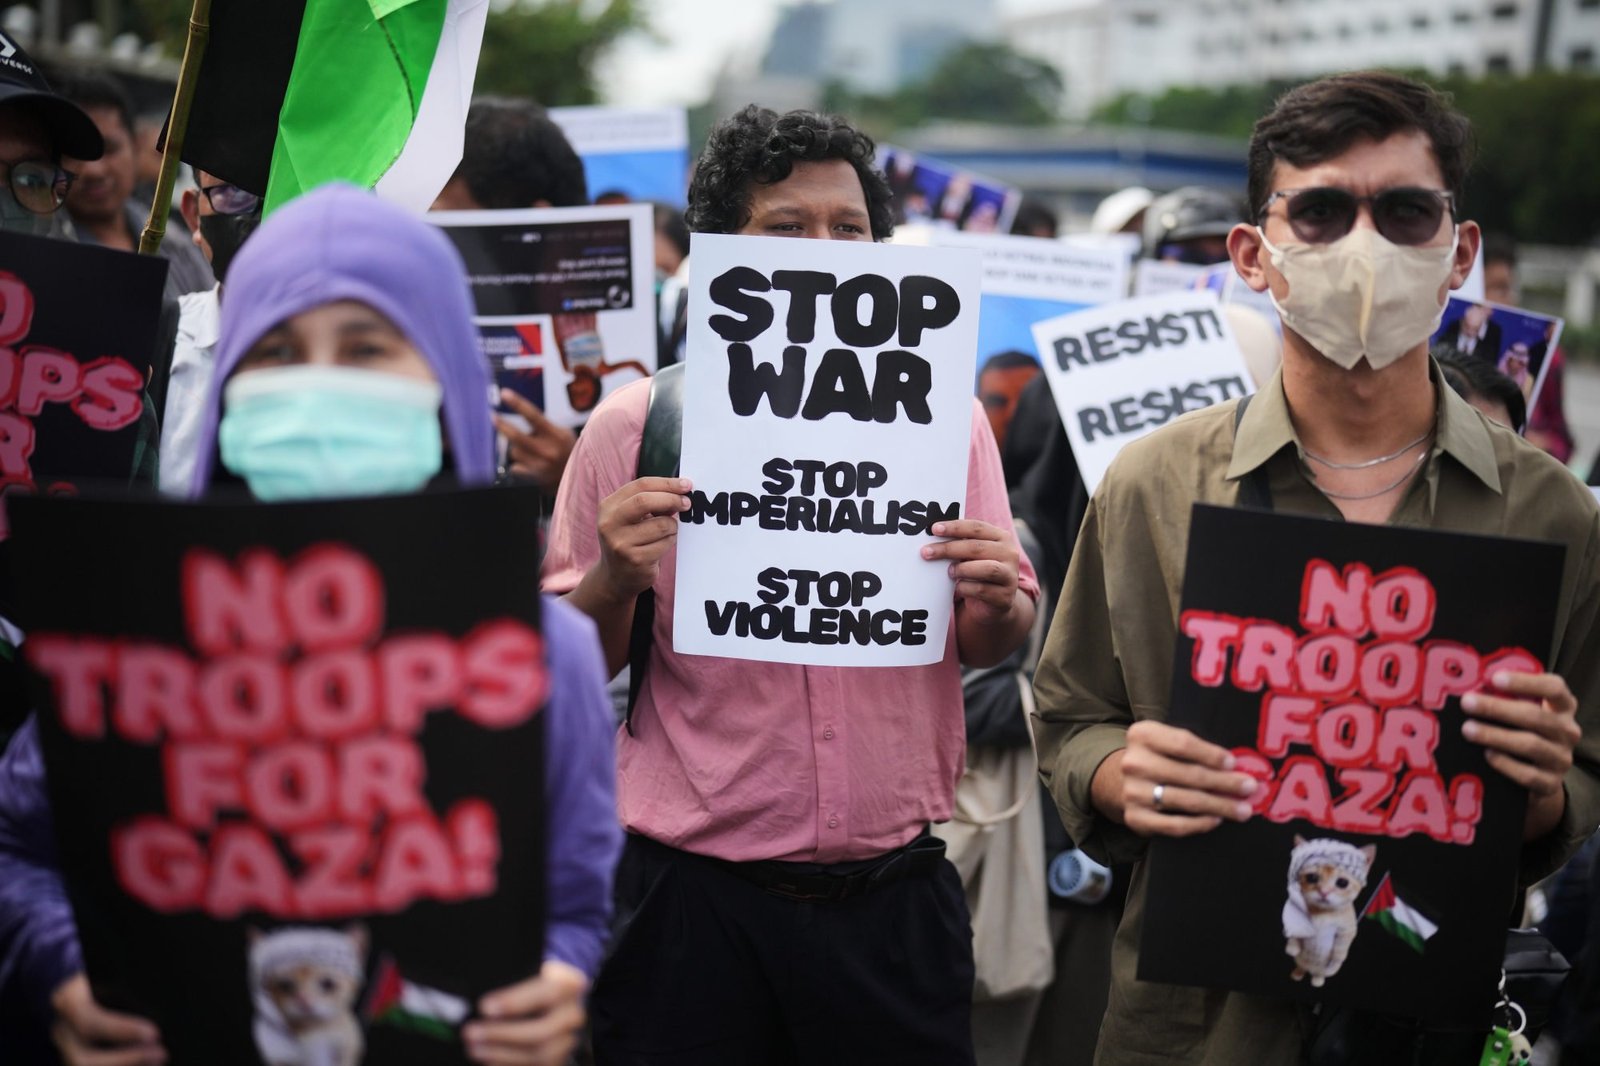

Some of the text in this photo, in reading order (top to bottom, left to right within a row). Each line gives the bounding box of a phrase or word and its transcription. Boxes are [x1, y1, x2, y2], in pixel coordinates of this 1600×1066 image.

[708, 266, 961, 348] STOP
[1052, 309, 1224, 373] RESIST!
[727, 342, 933, 425] WAR
[761, 457, 888, 499] STOP
[182, 541, 386, 657] NO
[704, 600, 929, 646] VIOLENCE
[756, 566, 883, 607] STOP
[1300, 558, 1437, 641] NO
[25, 618, 552, 743] TROOPS
[1257, 691, 1440, 772] FOR
[162, 734, 429, 832] FOR
[110, 797, 500, 921] GAZA!
